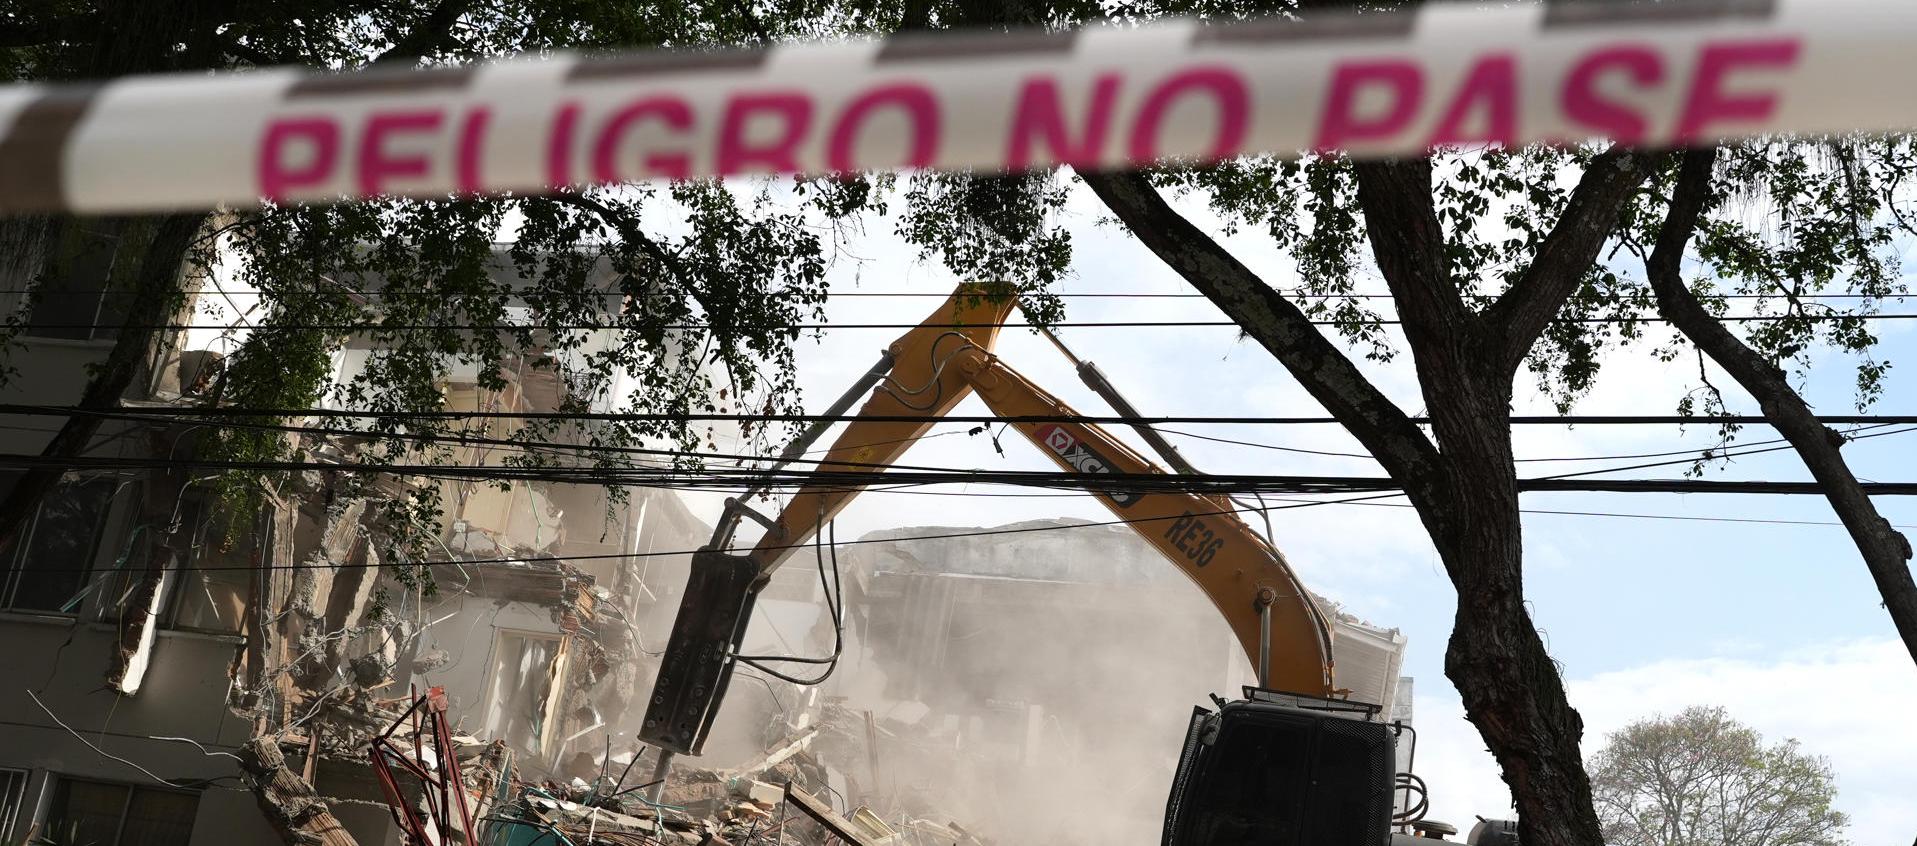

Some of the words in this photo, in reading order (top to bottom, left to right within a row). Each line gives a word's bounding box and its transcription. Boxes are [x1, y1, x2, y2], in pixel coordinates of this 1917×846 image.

[257, 83, 941, 207] PELIGRO
[1005, 67, 1251, 175] NO
[1313, 40, 1800, 161] PASE
[1163, 510, 1224, 567] RE36
